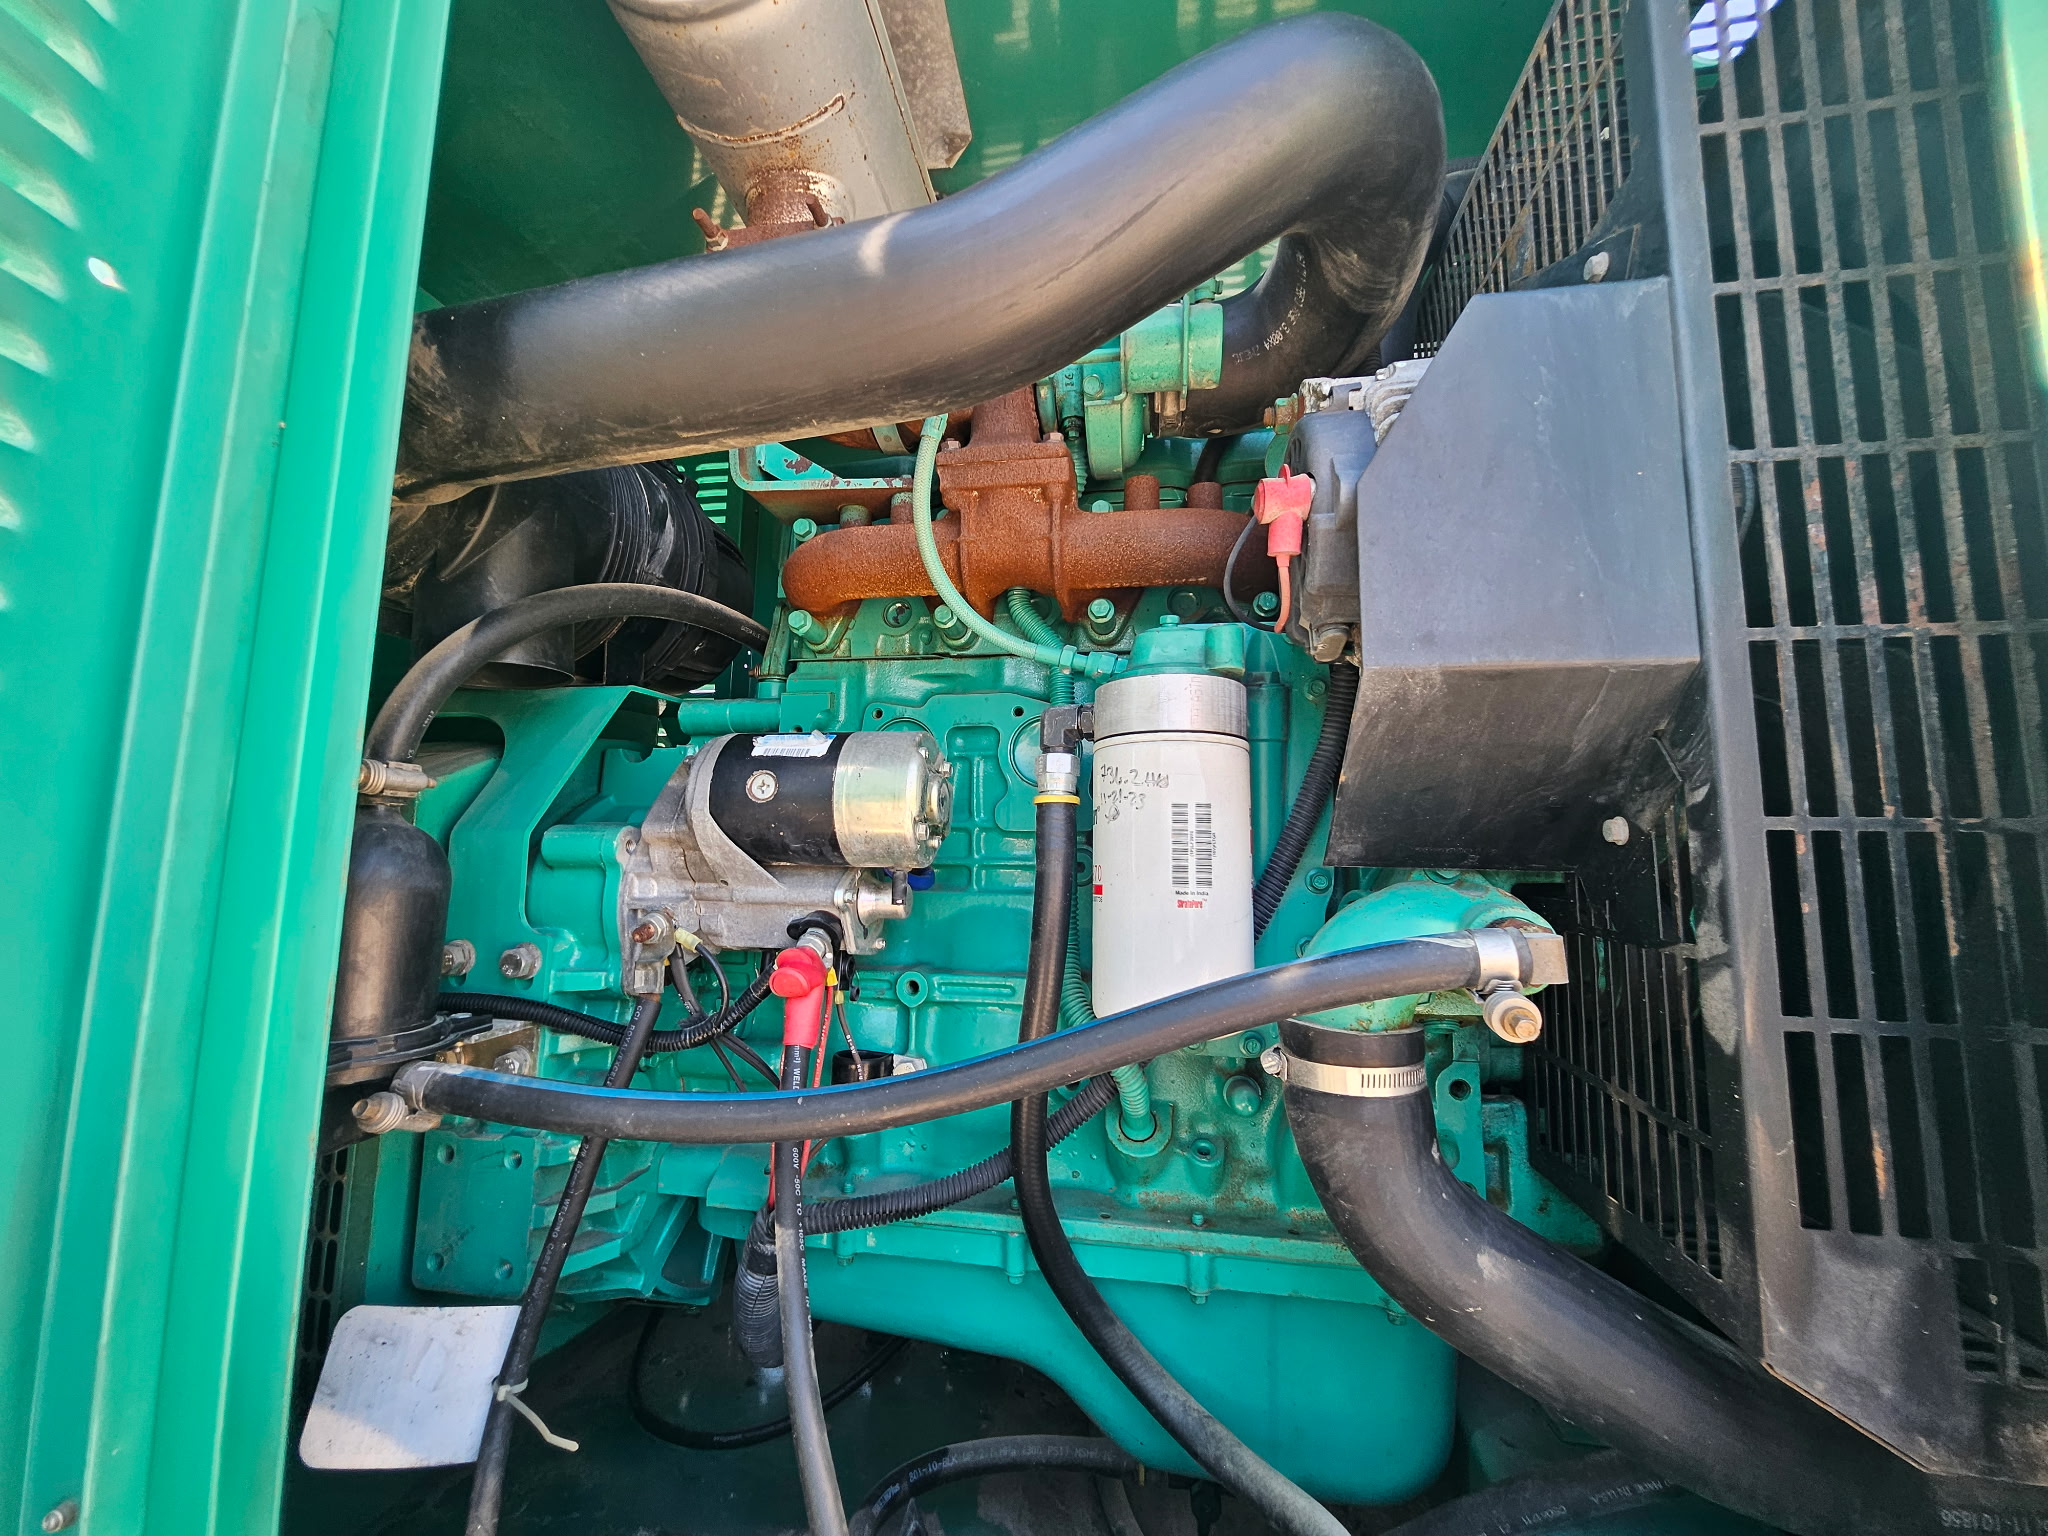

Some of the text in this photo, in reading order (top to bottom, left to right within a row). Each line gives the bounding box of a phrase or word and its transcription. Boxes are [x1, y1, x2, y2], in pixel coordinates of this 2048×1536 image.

[606, 1005, 643, 1087] CCI ROYAL/EXCELE
[552, 1198, 571, 1239] WELDING
[792, 1147, 800, 1170] 600V
[796, 1201, 803, 1216] TO
[805, 1295, 810, 1308] IN
[540, 1242, 554, 1273] CABLE
